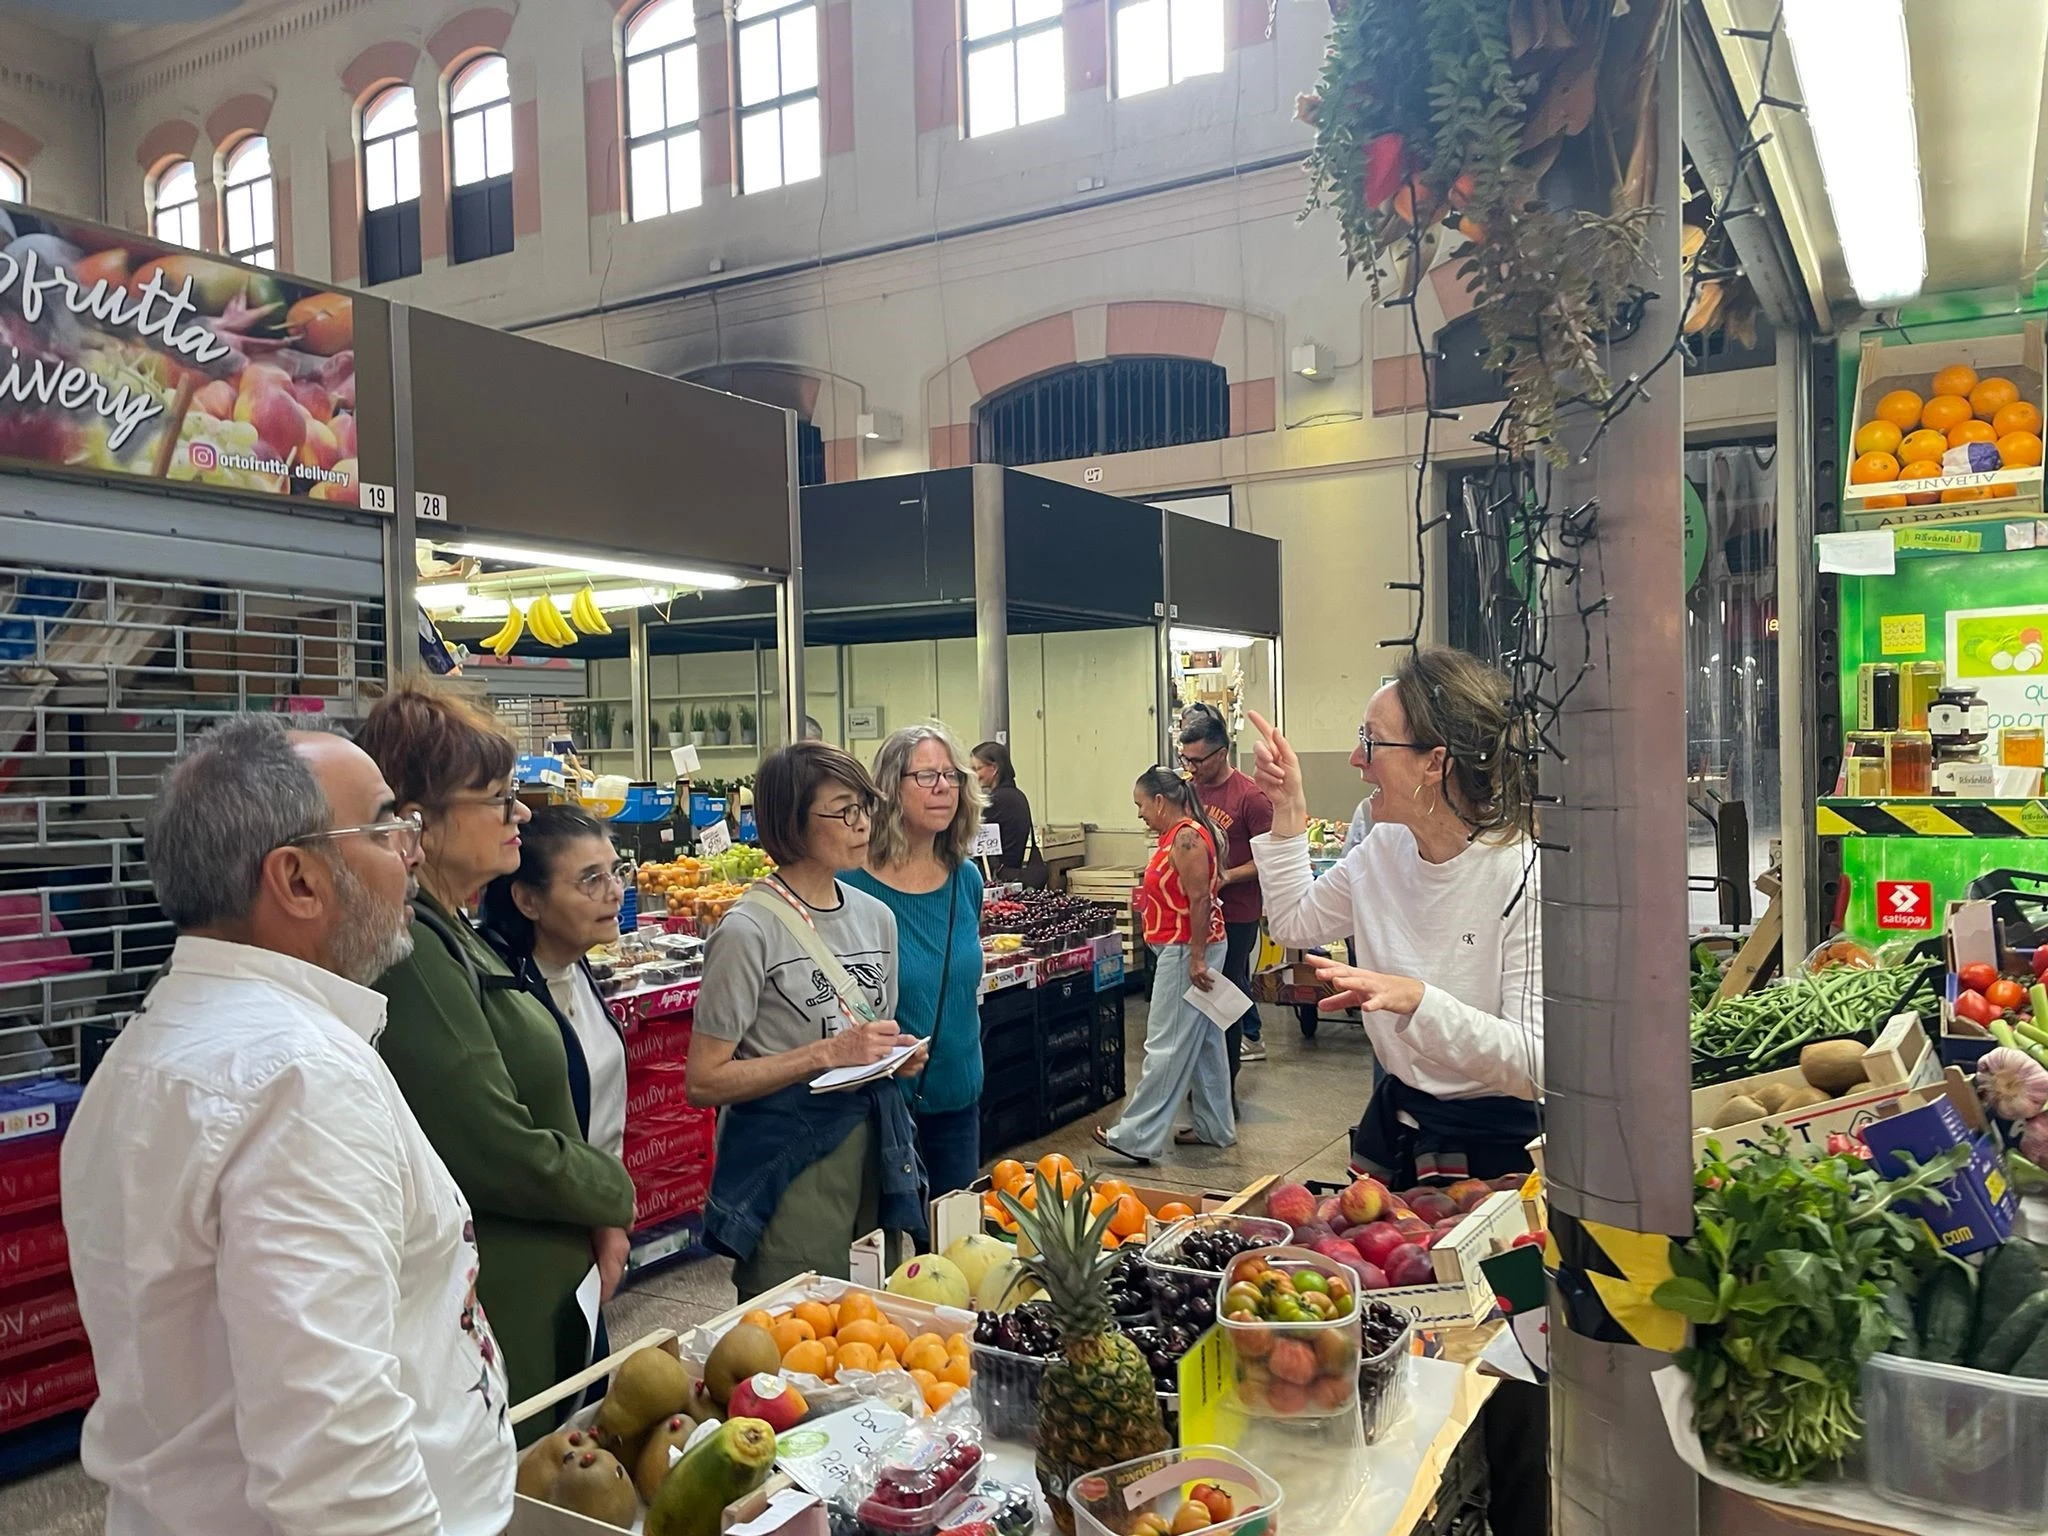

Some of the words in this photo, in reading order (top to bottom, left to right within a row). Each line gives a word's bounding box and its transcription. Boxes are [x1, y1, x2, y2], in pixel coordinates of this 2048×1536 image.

[1087, 469, 1100, 481] 27
[1917, 473, 1998, 490] ALBANI
[368, 487, 385, 508] 19
[422, 496, 440, 517] 28
[1882, 914, 1927, 927] satispay
